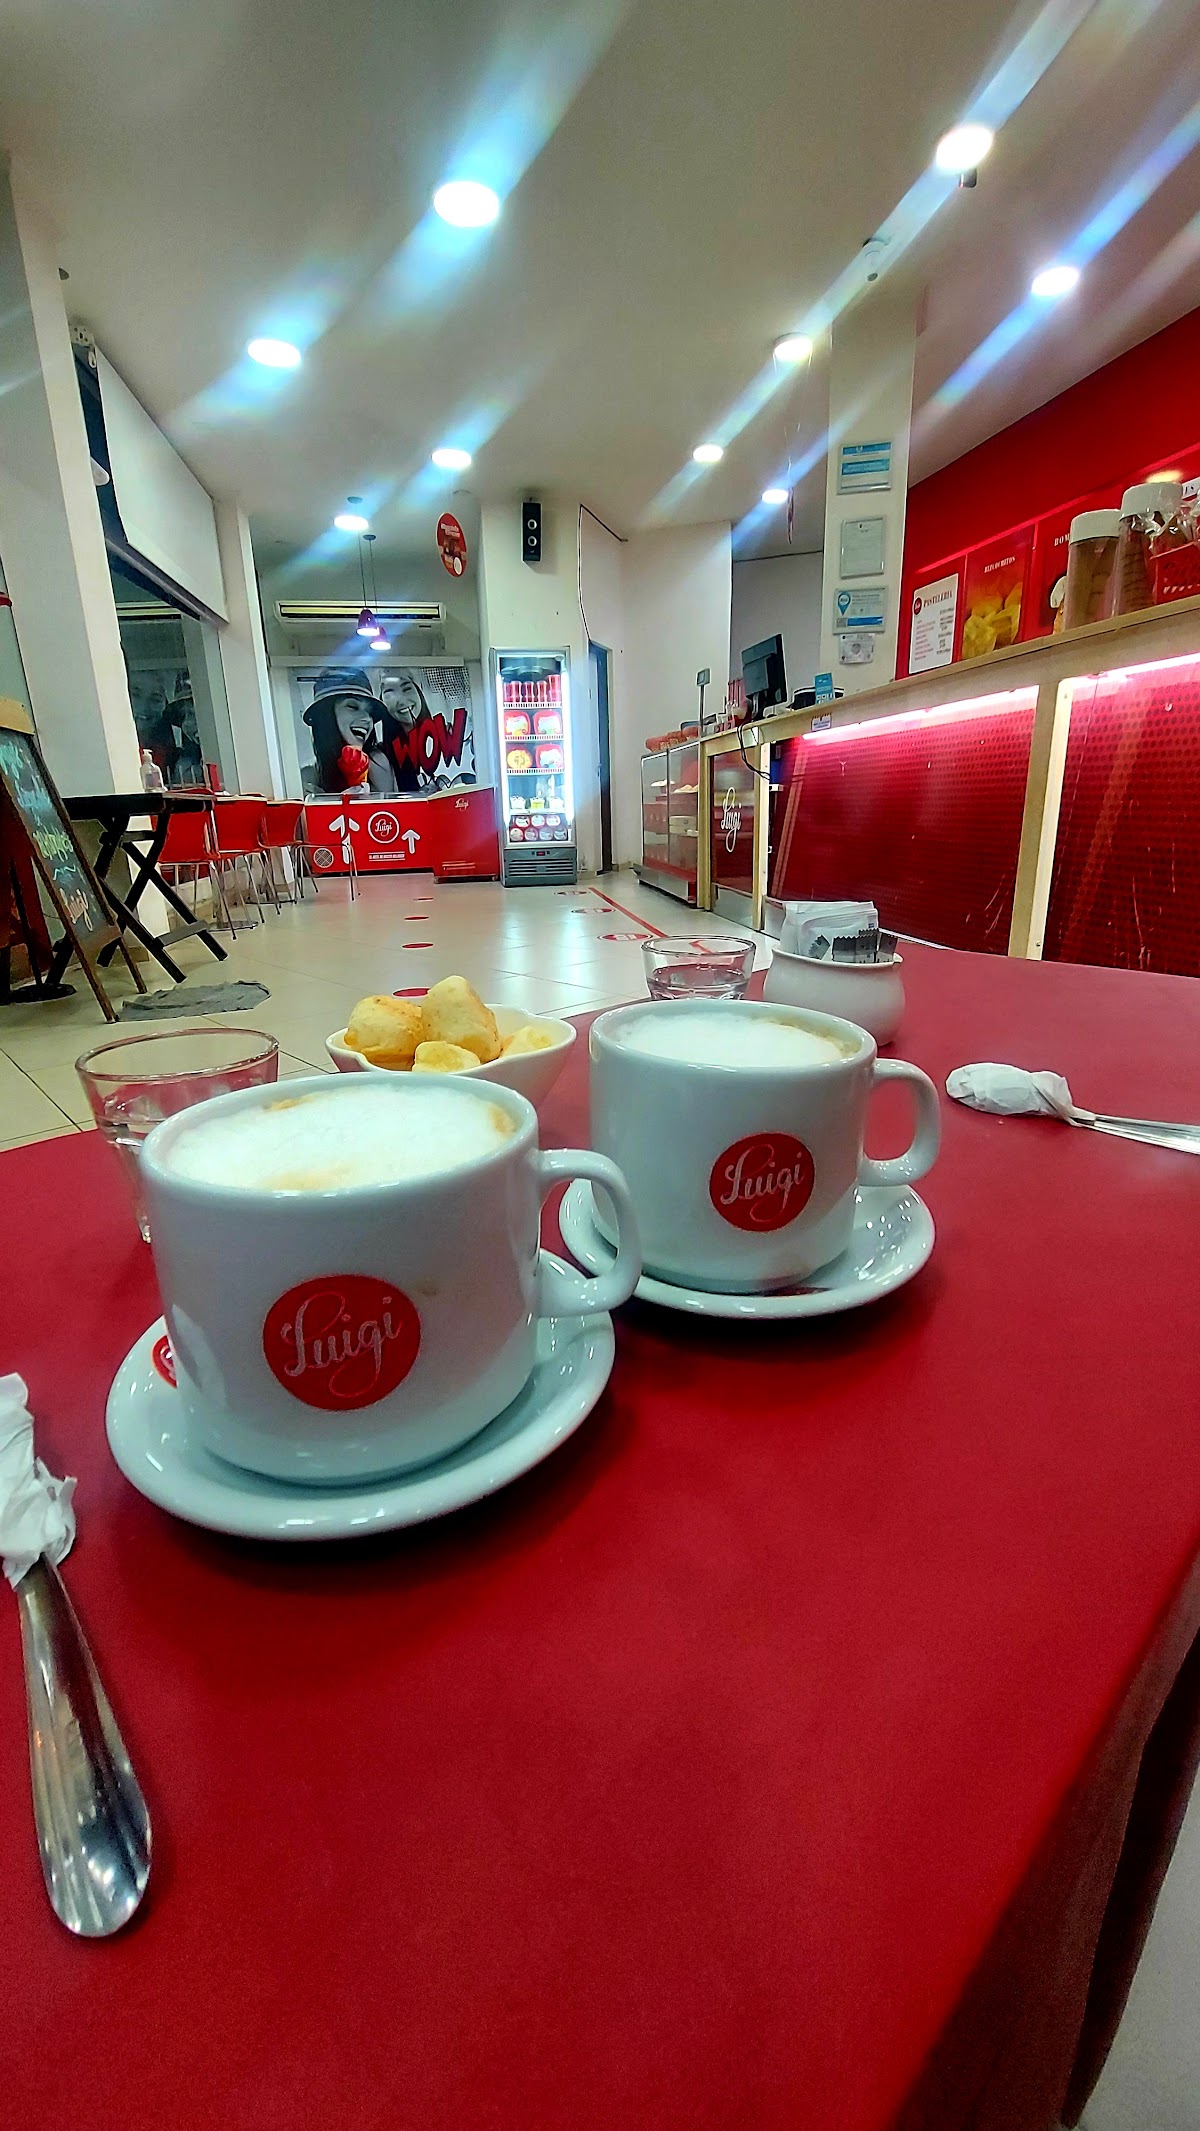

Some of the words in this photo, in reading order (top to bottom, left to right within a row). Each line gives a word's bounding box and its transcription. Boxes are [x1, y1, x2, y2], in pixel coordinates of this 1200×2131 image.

[391, 707, 468, 773] WOW
[374, 818, 394, 838] Luigi
[720, 787, 742, 853] Luigi
[720, 1143, 806, 1223] Luigi
[280, 1290, 405, 1399] Luigi
